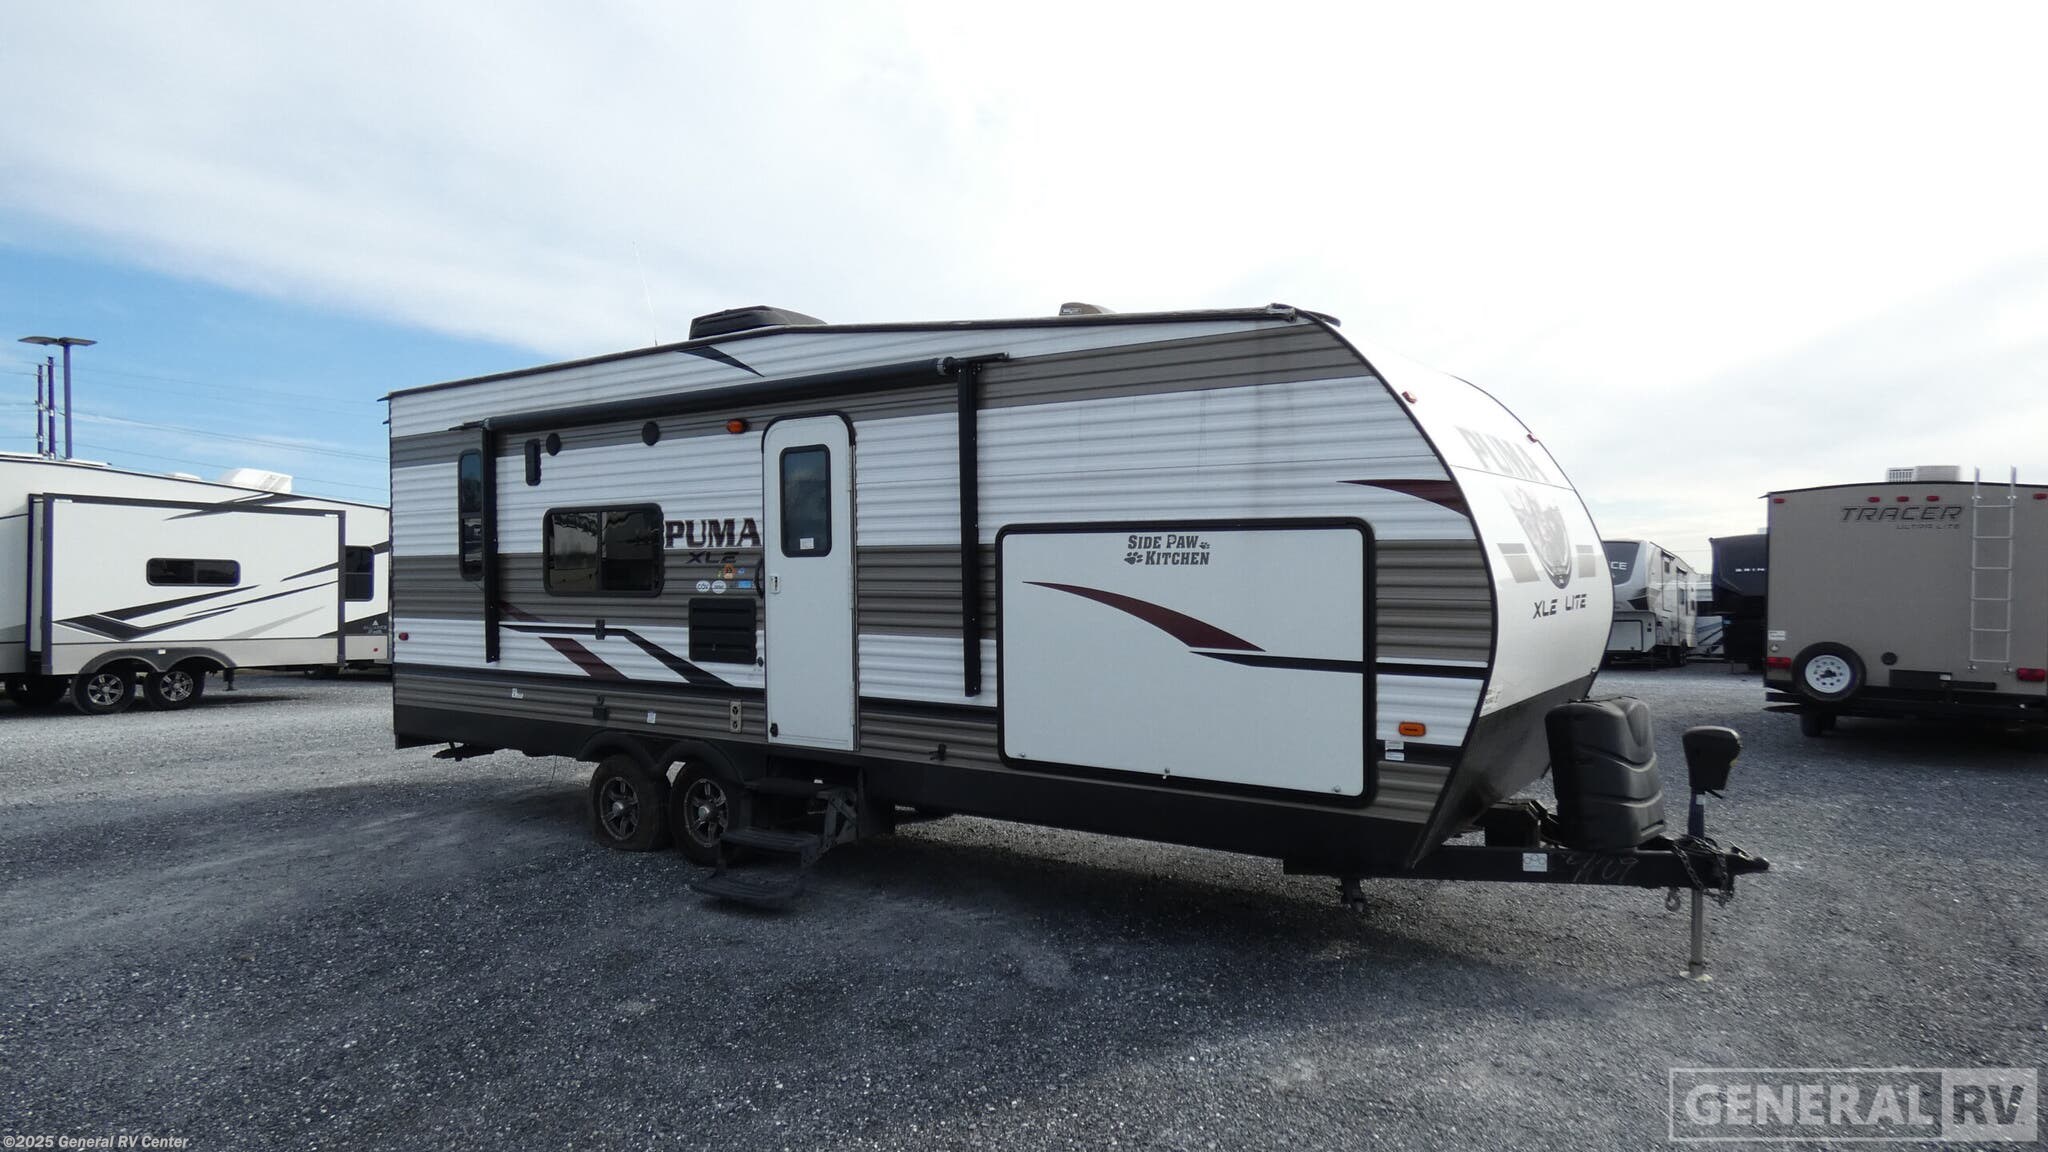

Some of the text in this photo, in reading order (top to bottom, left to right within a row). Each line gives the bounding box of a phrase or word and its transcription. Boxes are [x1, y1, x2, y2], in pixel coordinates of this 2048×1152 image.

[1841, 505, 1964, 521] TRACER
[664, 517, 762, 549] PUMA
[1128, 534, 1199, 549] SIDE PAW
[686, 551, 740, 564] XLE
[1145, 551, 1210, 565] KITCHEN
[1608, 561, 1628, 570] CE
[1533, 594, 1587, 619] XLE LITE
